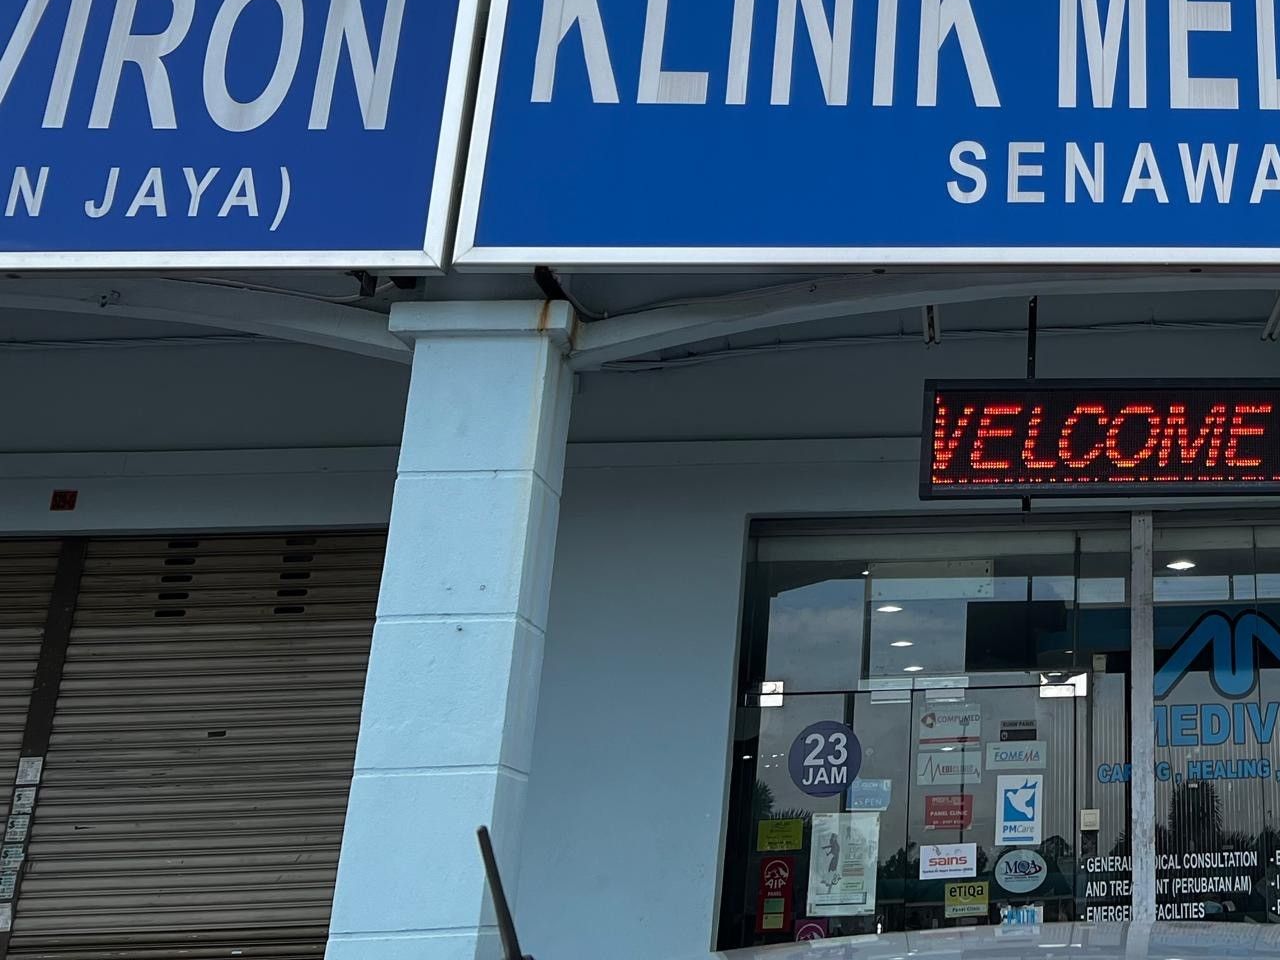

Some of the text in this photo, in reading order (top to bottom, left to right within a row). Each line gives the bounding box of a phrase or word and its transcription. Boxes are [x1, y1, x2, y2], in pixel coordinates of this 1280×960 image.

[84, 165, 292, 232] JAYA)
[803, 732, 848, 766] 23
[801, 766, 848, 786] JAM
[1097, 760, 1172, 784] CAG
[1187, 758, 1272, 782] HEALING
[928, 856, 968, 867] sains
[1086, 855, 1133, 873] GENERAL
[1183, 851, 1258, 869] CONSULTATION
[1085, 874, 1252, 898] AND TRENT (PERUBATAN AM)
[1086, 904, 1133, 922] EMERGE
